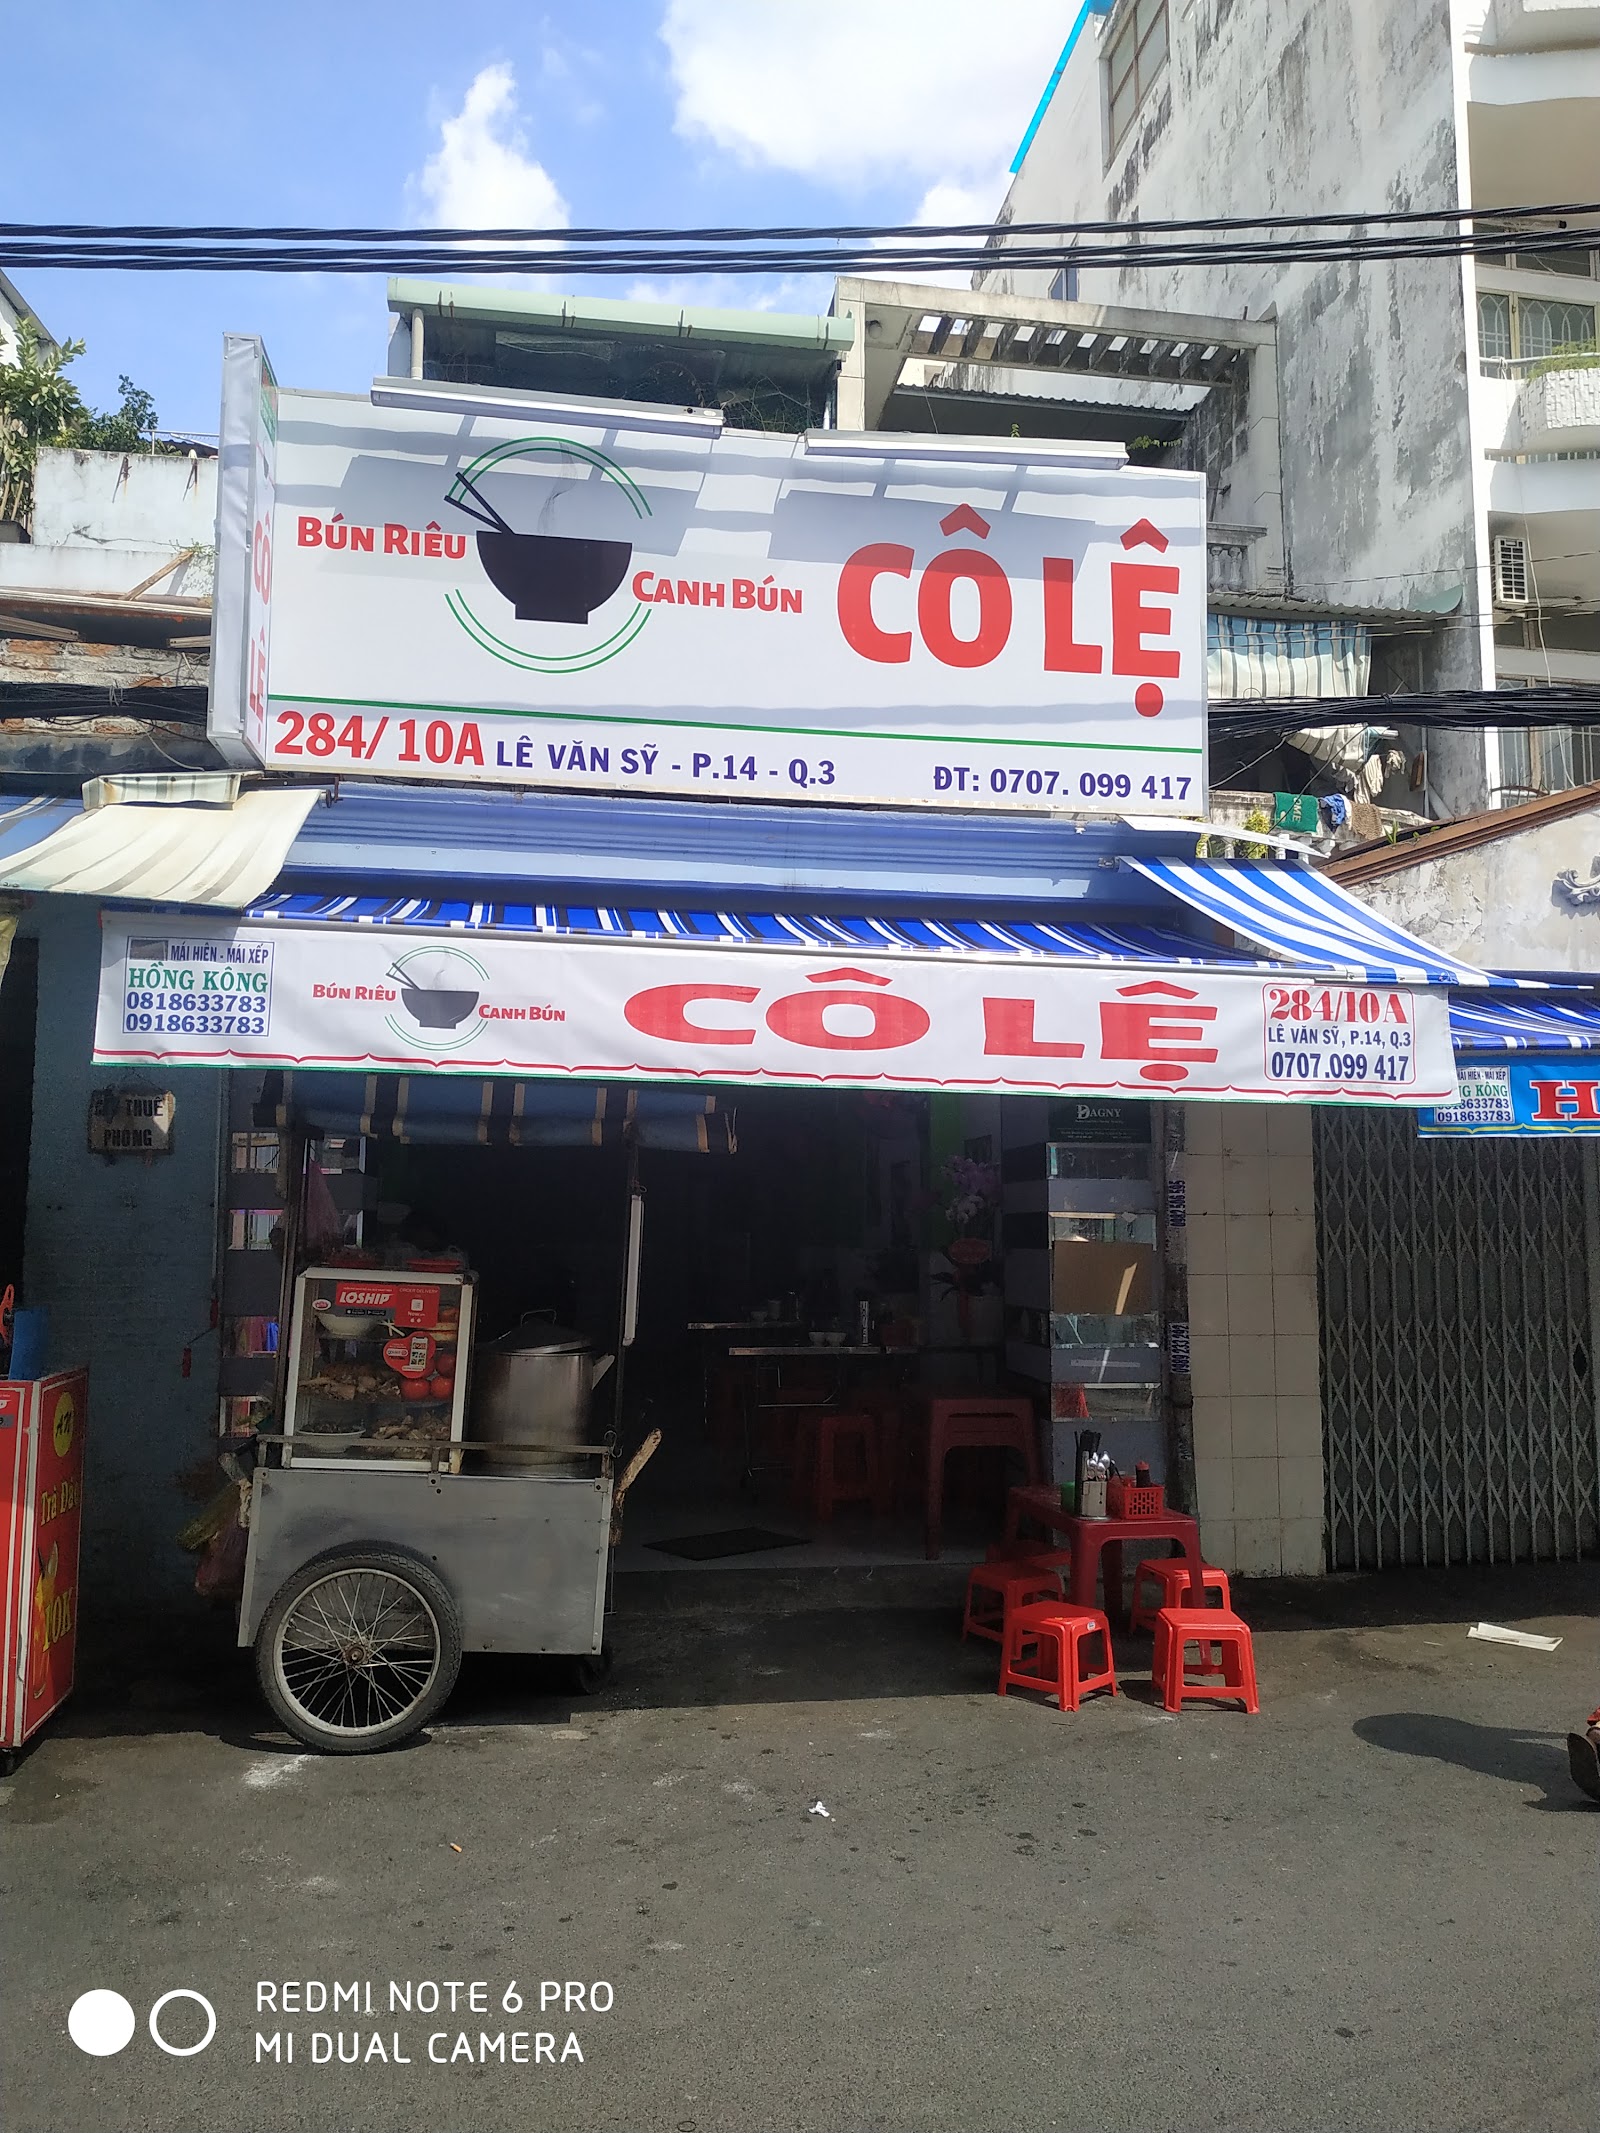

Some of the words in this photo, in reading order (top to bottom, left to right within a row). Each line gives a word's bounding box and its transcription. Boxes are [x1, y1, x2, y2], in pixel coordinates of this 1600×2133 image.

[297, 512, 374, 553] BÚN
[383, 520, 467, 560] RIÊU
[632, 570, 725, 608] CANH
[732, 574, 803, 614] BÚN
[837, 503, 1013, 668] CÔ
[1043, 518, 1181, 718] LỆ
[497, 735, 534, 769] LÊ
[547, 739, 611, 773] VĂN
[620, 743, 660, 776] SỸ
[692, 754, 758, 781] P.14
[788, 759, 836, 788] Q.3
[933, 766, 980, 792] ĐT:
[990, 768, 1069, 795] 0707.
[1079, 772, 1131, 798] 099
[1141, 775, 1192, 801] 417
[171, 942, 190, 961] MÁI
[192, 942, 217, 962] HIÊN
[227, 944, 246, 963] MÁI
[248, 943, 269, 964] XẾP
[128, 961, 195, 990] HỒNG
[202, 966, 268, 993] KÔNG
[126, 991, 266, 1013] 0818633783
[312, 982, 351, 999] BÚN
[355, 984, 396, 1001] RIÊU
[478, 1004, 526, 1020] CANH
[529, 1004, 566, 1021] BÚN
[1269, 988, 1409, 1024] 284/10A
[126, 1012, 265, 1034] 0918633783
[624, 967, 931, 1051] CÔ
[982, 980, 1218, 1082] LỆ
[1268, 1023, 1285, 1043] LÊ
[1290, 1025, 1318, 1044] VĂN
[1322, 1026, 1346, 1048] SỸ,
[1350, 1030, 1386, 1050] P.14,
[1390, 1031, 1411, 1050] Q.3
[1271, 1051, 1368, 1080] 0707.099
[1374, 1054, 1409, 1081] 417
[1475, 1082, 1508, 1098] KÔNG
[1437, 1110, 1511, 1122] 0918633783
[339, 1291, 394, 1305] LOSHIP
